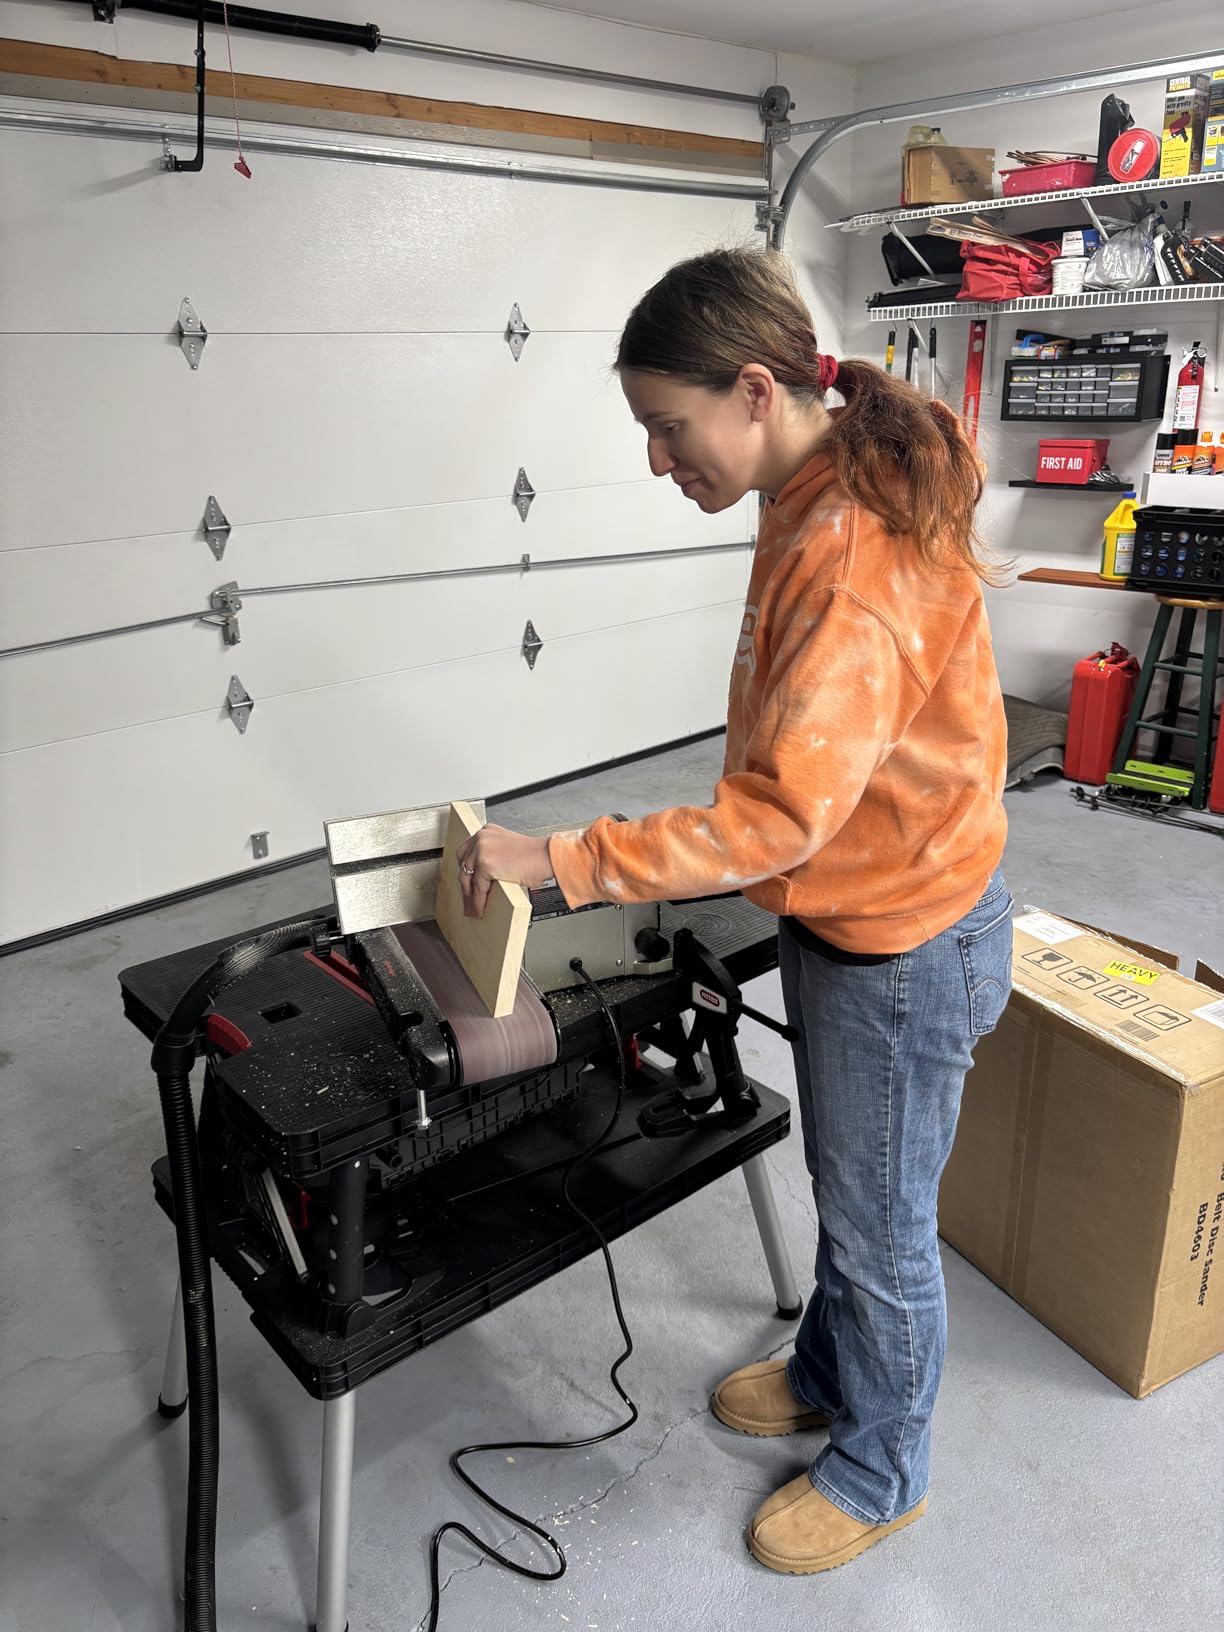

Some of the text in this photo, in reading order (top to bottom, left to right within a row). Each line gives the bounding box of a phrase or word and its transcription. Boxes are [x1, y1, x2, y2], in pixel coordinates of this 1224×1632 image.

[1040, 456, 1083, 470] FIRST AID
[1110, 962, 1158, 979] HEAVY
[1213, 1191, 1224, 1223] Belt
[1190, 1202, 1208, 1262] BD4603
[1206, 1225, 1219, 1256] Disc
